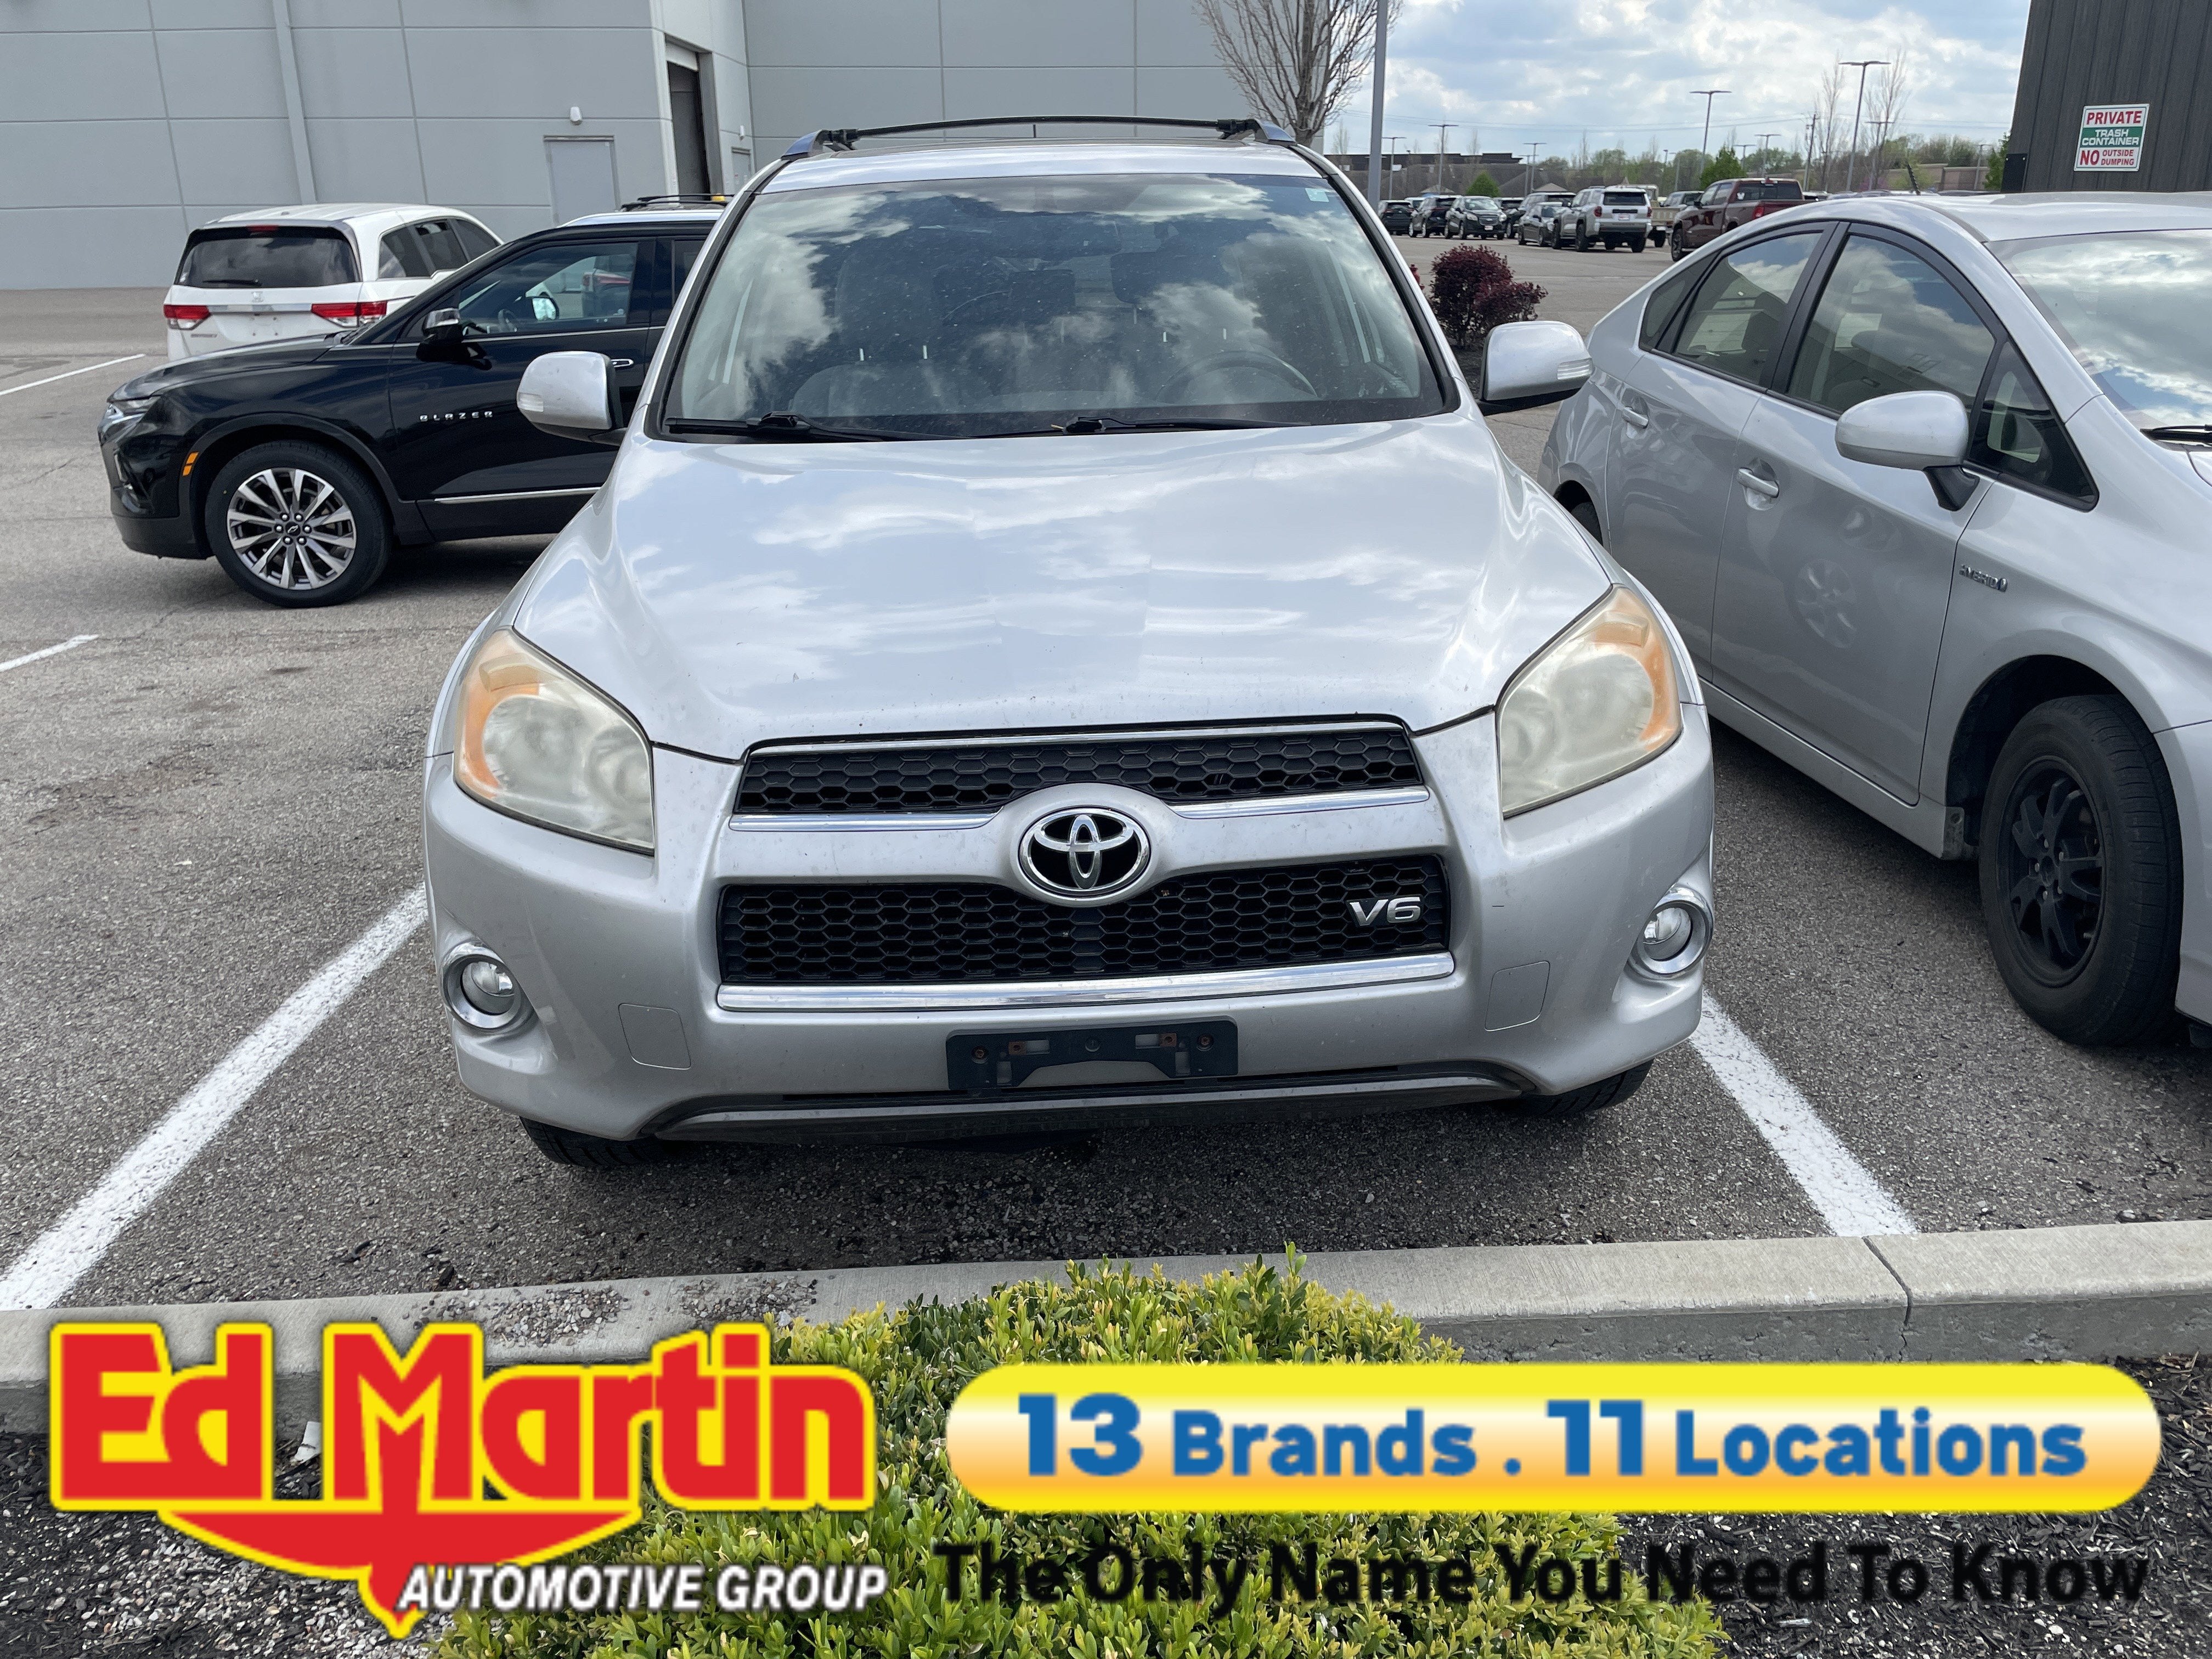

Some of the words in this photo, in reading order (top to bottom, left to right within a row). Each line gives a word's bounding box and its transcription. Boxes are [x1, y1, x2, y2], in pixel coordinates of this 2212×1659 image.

[2086, 111, 2142, 125] PRIVATE
[2095, 129, 2129, 137] TRASH
[2081, 137, 2139, 145] CONTAINER
[2080, 150, 2100, 165] NO
[420, 411, 493, 422] BLAZER
[1350, 896, 1421, 926] V6
